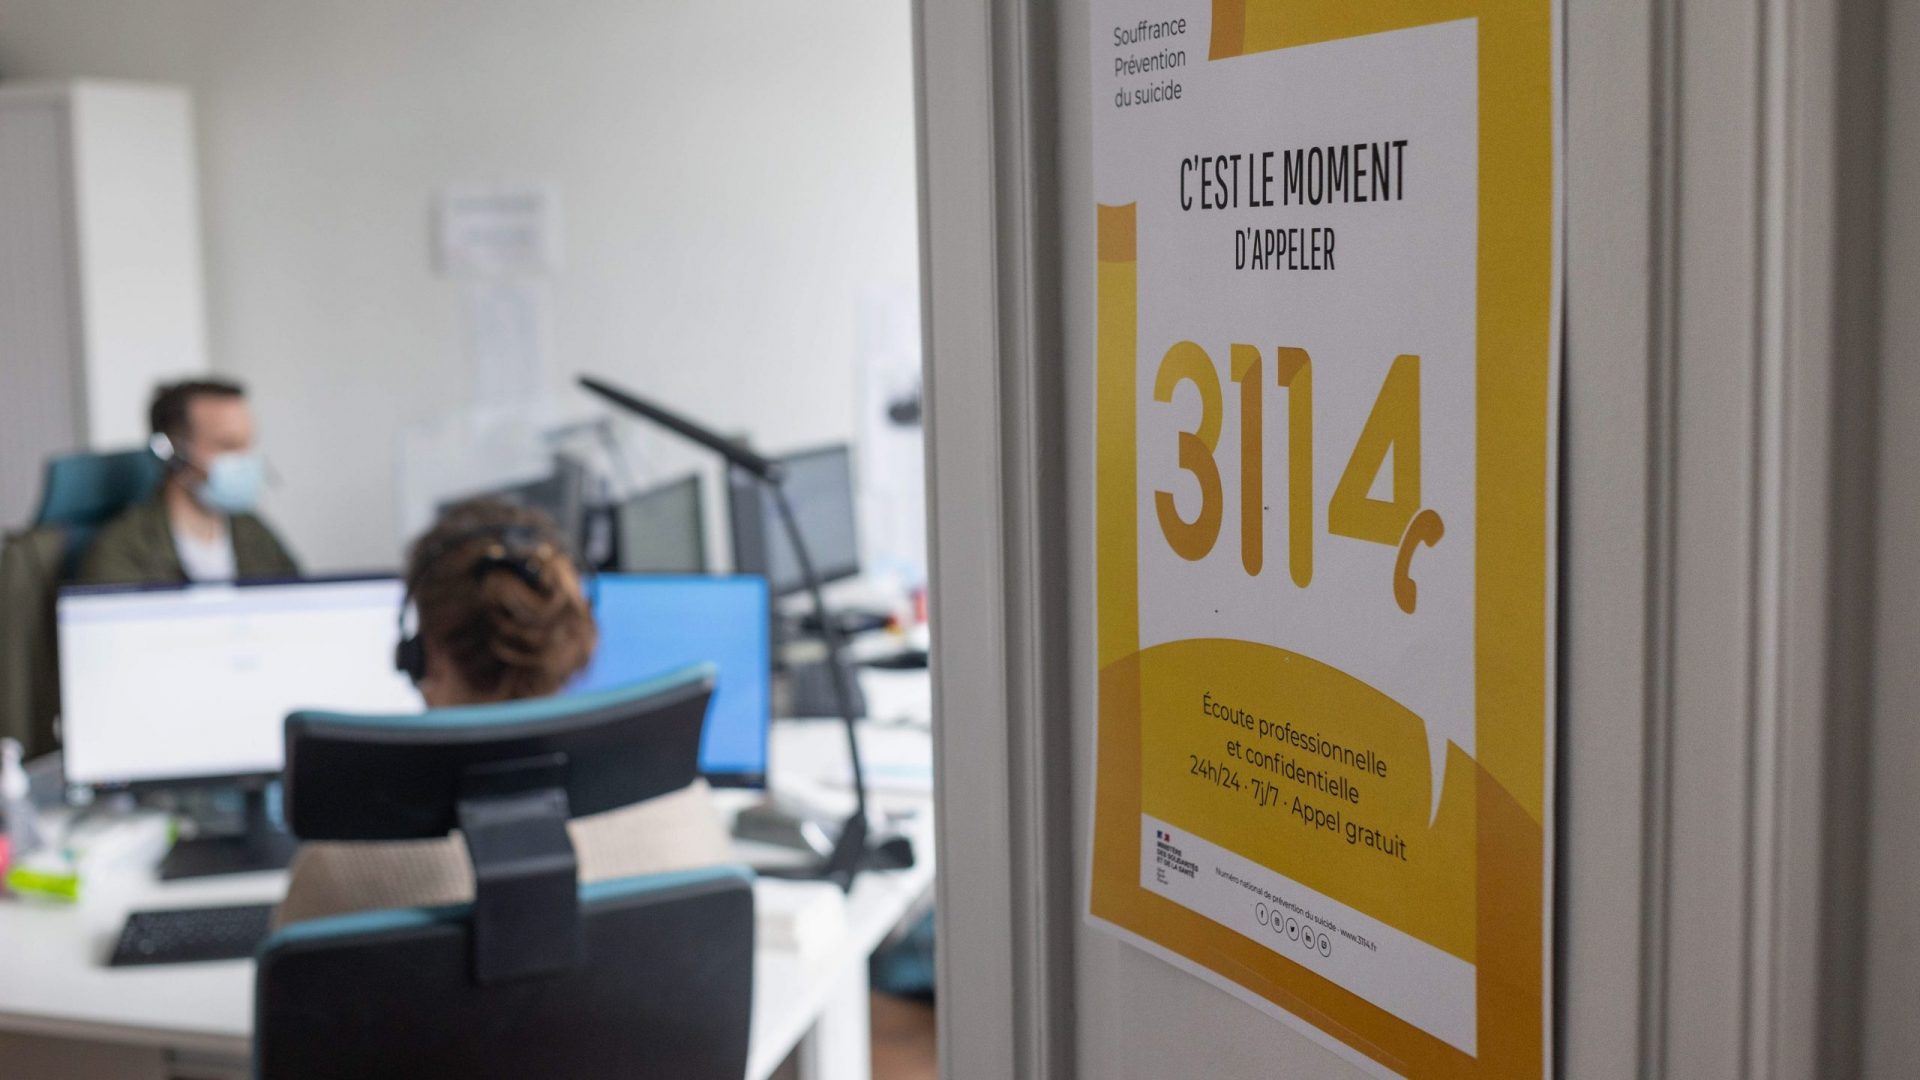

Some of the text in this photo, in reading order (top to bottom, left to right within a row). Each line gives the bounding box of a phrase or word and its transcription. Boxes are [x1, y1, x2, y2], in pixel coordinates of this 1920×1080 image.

[1113, 18, 1187, 47] Souffrance
[1114, 48, 1187, 77] Prévention
[1114, 80, 1182, 108] du suicide
[1180, 139, 1408, 211] C'EST LE MOMENT
[1235, 227, 1336, 271] D'APPELER
[1153, 340, 1421, 589] 3114
[1202, 691, 1388, 778] Écoute professionnelle
[1226, 740, 1360, 804] et confidentielle
[1190, 754, 1407, 862] 24h/24 7j/7 Appel gratuit
[1239, 879, 1264, 896] national
[1264, 891, 1272, 900] de
[1272, 894, 1305, 916] prévention
[1305, 910, 1314, 921] du
[1314, 915, 1336, 933] suicide
